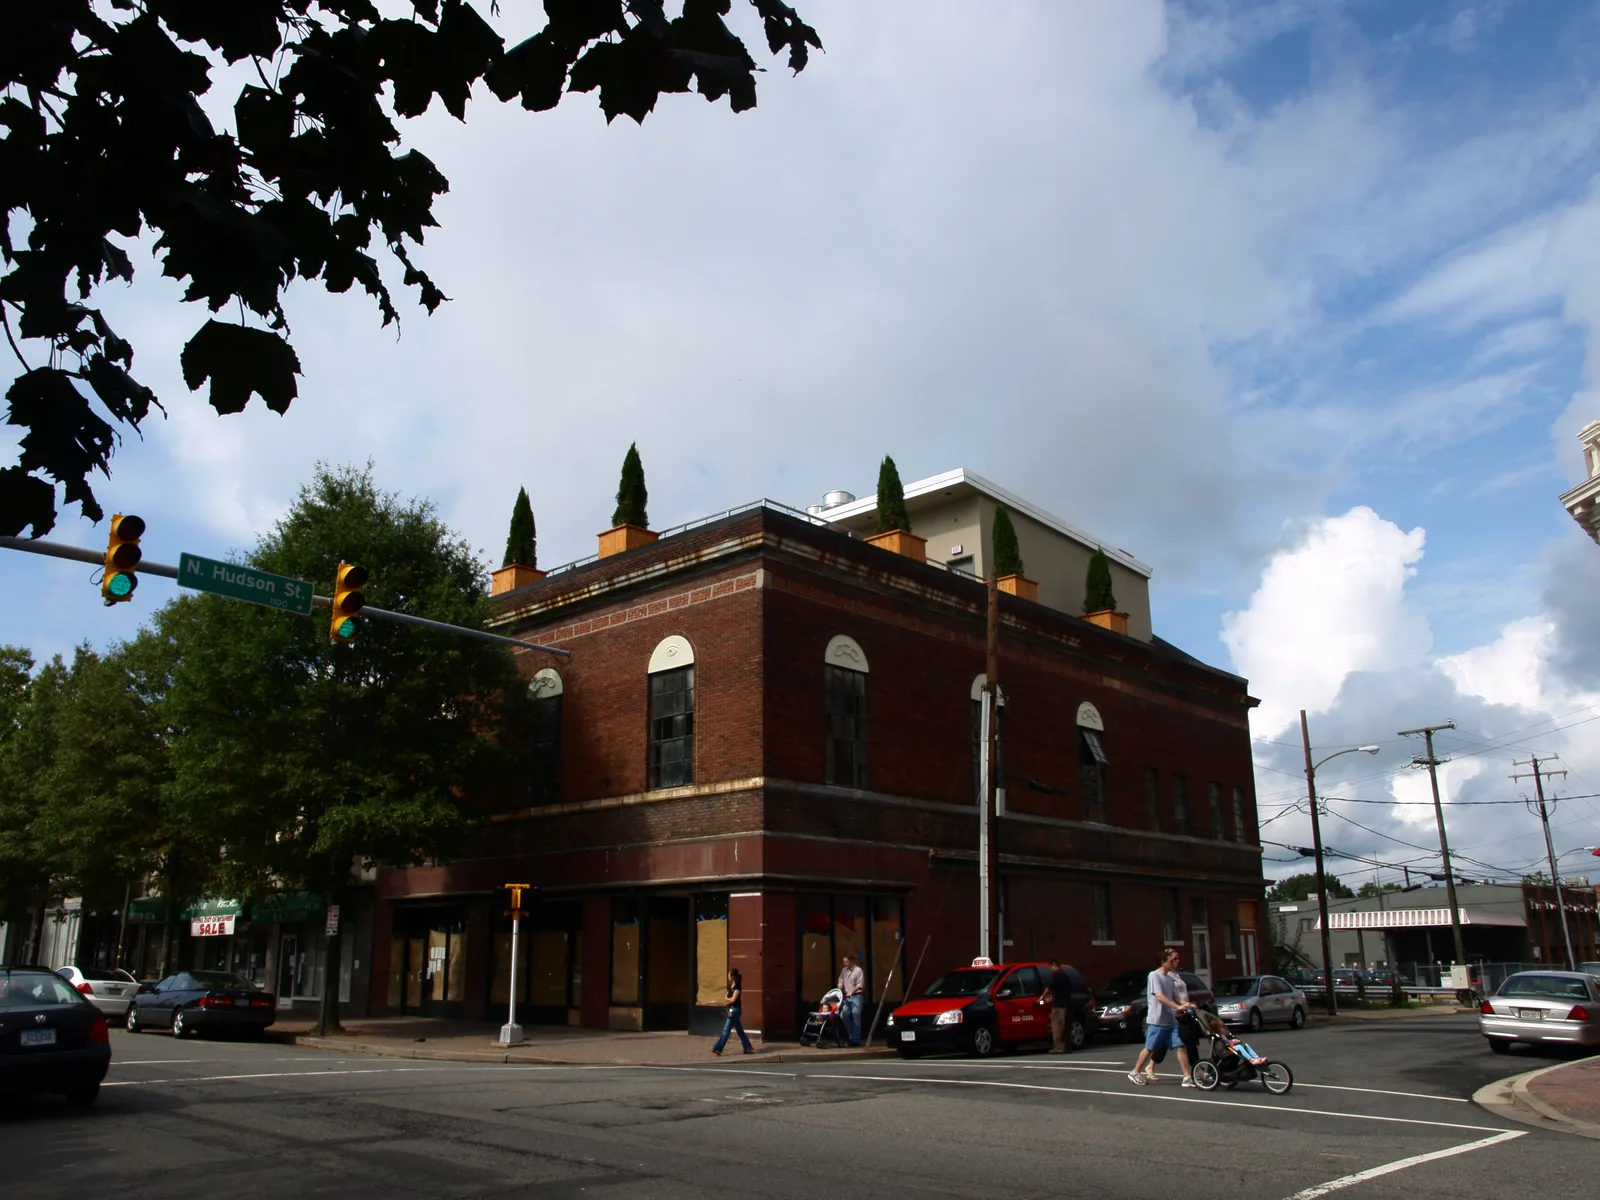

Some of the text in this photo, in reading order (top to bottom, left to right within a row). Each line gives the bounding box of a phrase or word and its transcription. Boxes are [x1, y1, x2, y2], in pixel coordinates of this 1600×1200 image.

[187, 559, 305, 600] N. Hudson St.
[270, 597, 288, 609] 1100
[199, 923, 224, 935] SALE
